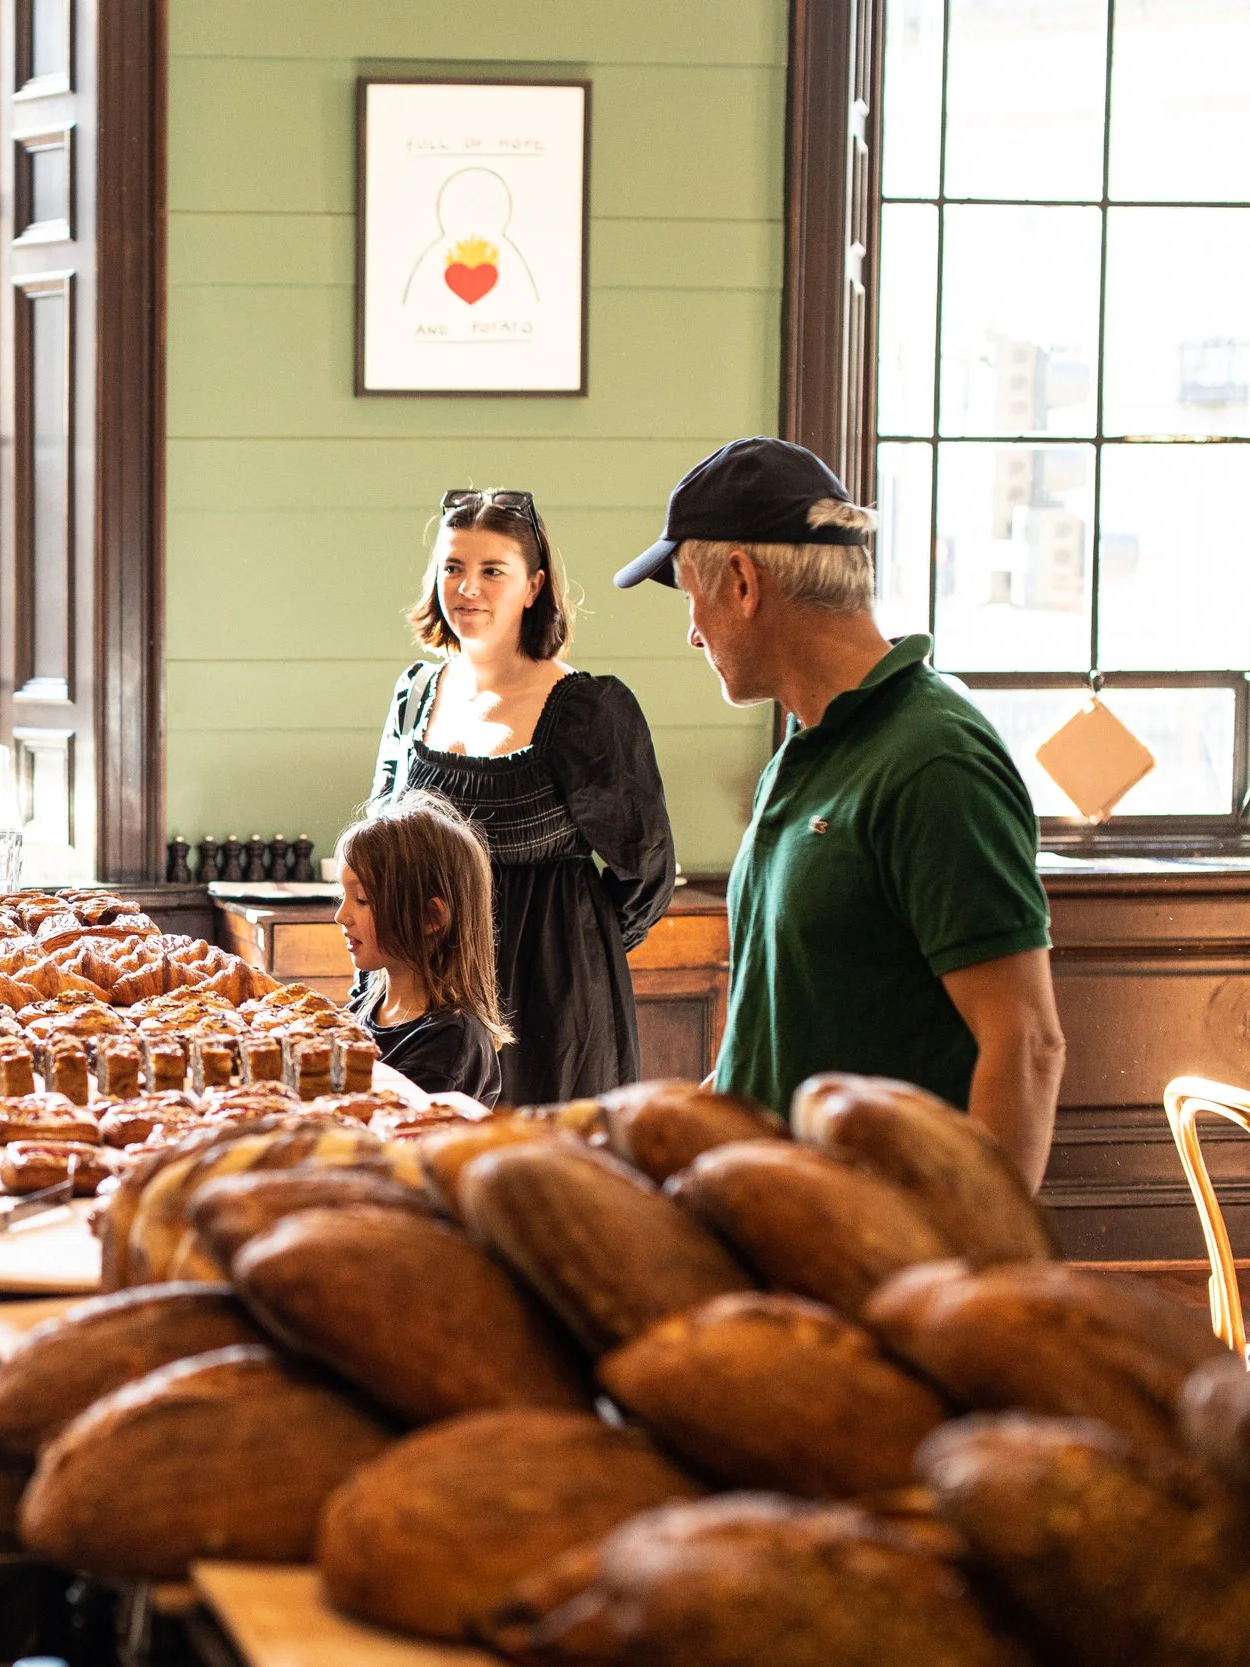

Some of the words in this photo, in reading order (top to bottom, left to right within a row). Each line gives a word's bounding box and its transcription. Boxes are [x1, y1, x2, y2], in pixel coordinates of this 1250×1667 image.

[406, 136, 449, 152] FULL
[464, 137, 482, 149] OF
[498, 137, 546, 151] HOPE
[414, 323, 449, 337] AND
[471, 320, 533, 334] POTATO
